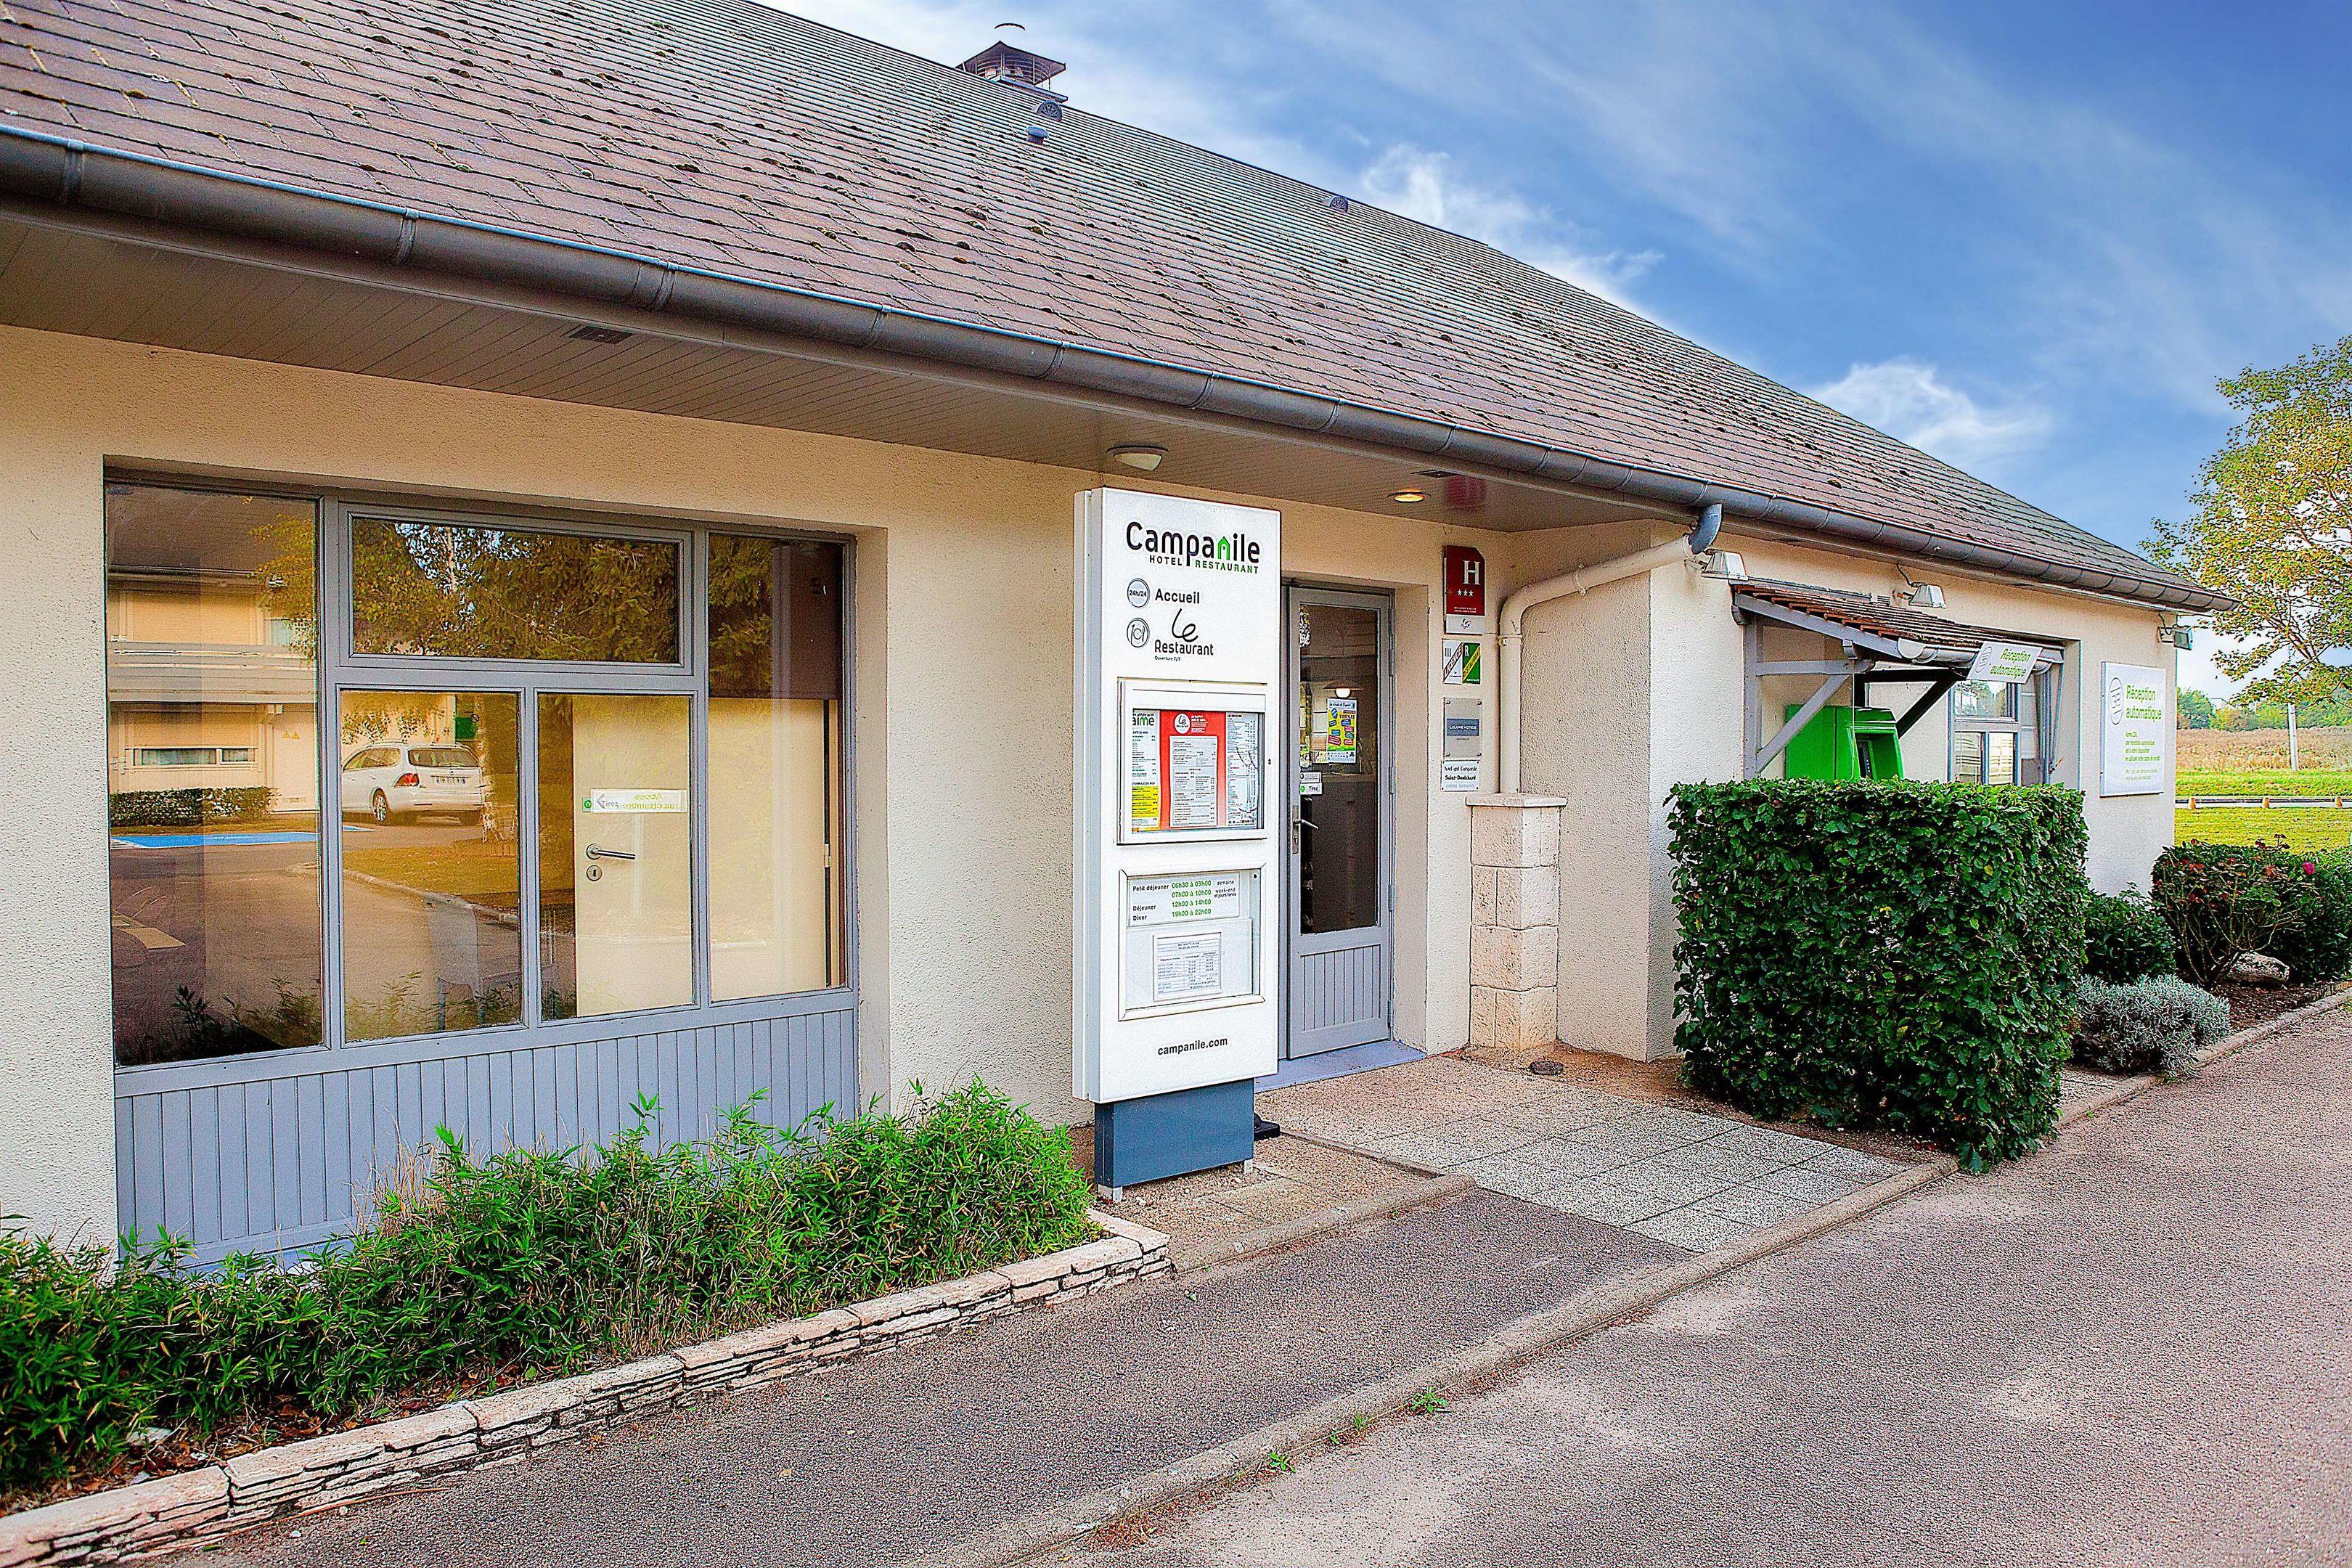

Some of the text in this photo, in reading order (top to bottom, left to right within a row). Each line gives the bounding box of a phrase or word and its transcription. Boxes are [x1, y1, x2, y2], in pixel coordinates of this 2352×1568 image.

[1126, 521, 1260, 567] Campanile
[1149, 555, 1259, 574] HOTEL RESTAURANT
[1462, 560, 1481, 585] H
[1154, 588, 1200, 605] Accueil
[1154, 639, 1214, 656] Restaurant
[1464, 645, 1469, 657] R
[2001, 648, 2030, 663] Réception
[1990, 663, 2027, 679] automatique
[2126, 685, 2156, 703] Réception
[2126, 705, 2162, 722] automatique
[1158, 1038, 1228, 1055] campanile.com
